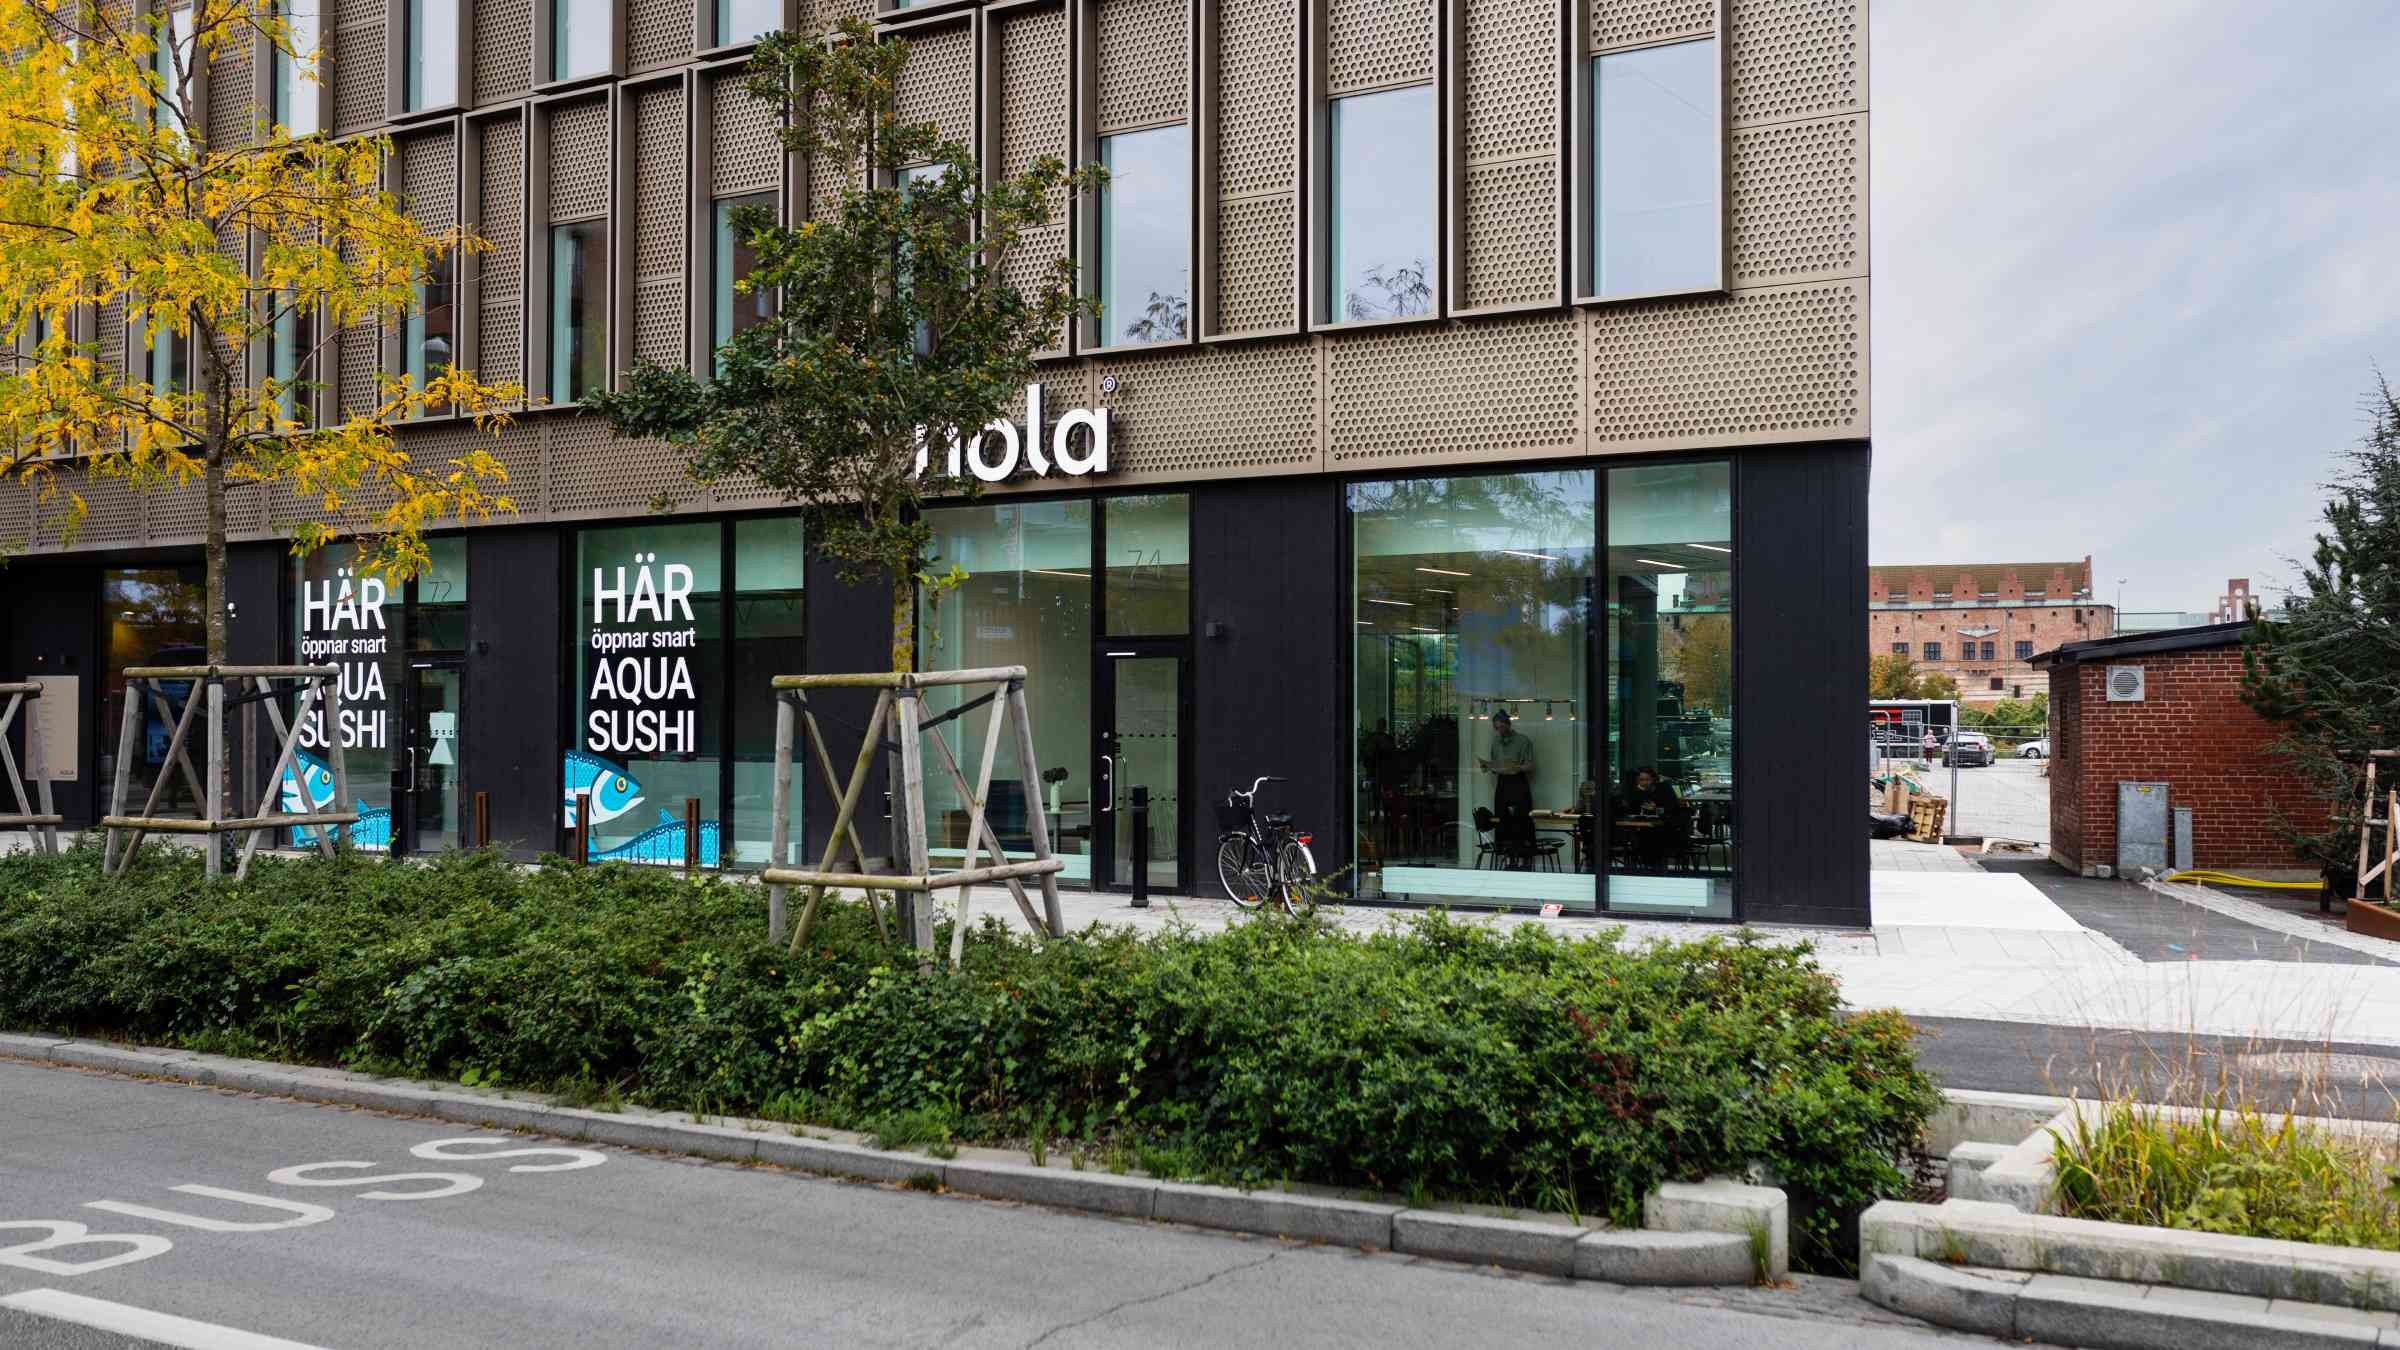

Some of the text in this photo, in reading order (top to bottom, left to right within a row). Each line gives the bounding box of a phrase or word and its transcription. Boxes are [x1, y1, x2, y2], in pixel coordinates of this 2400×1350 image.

[303, 567, 386, 632] HÄR
[594, 552, 696, 624] HÄR
[301, 635, 387, 660] öppnar snart
[591, 627, 696, 654] öppnar snart
[590, 656, 696, 706] AQUA
[587, 709, 695, 753] SUSHI
[0, 1136, 608, 1277] BUSS
